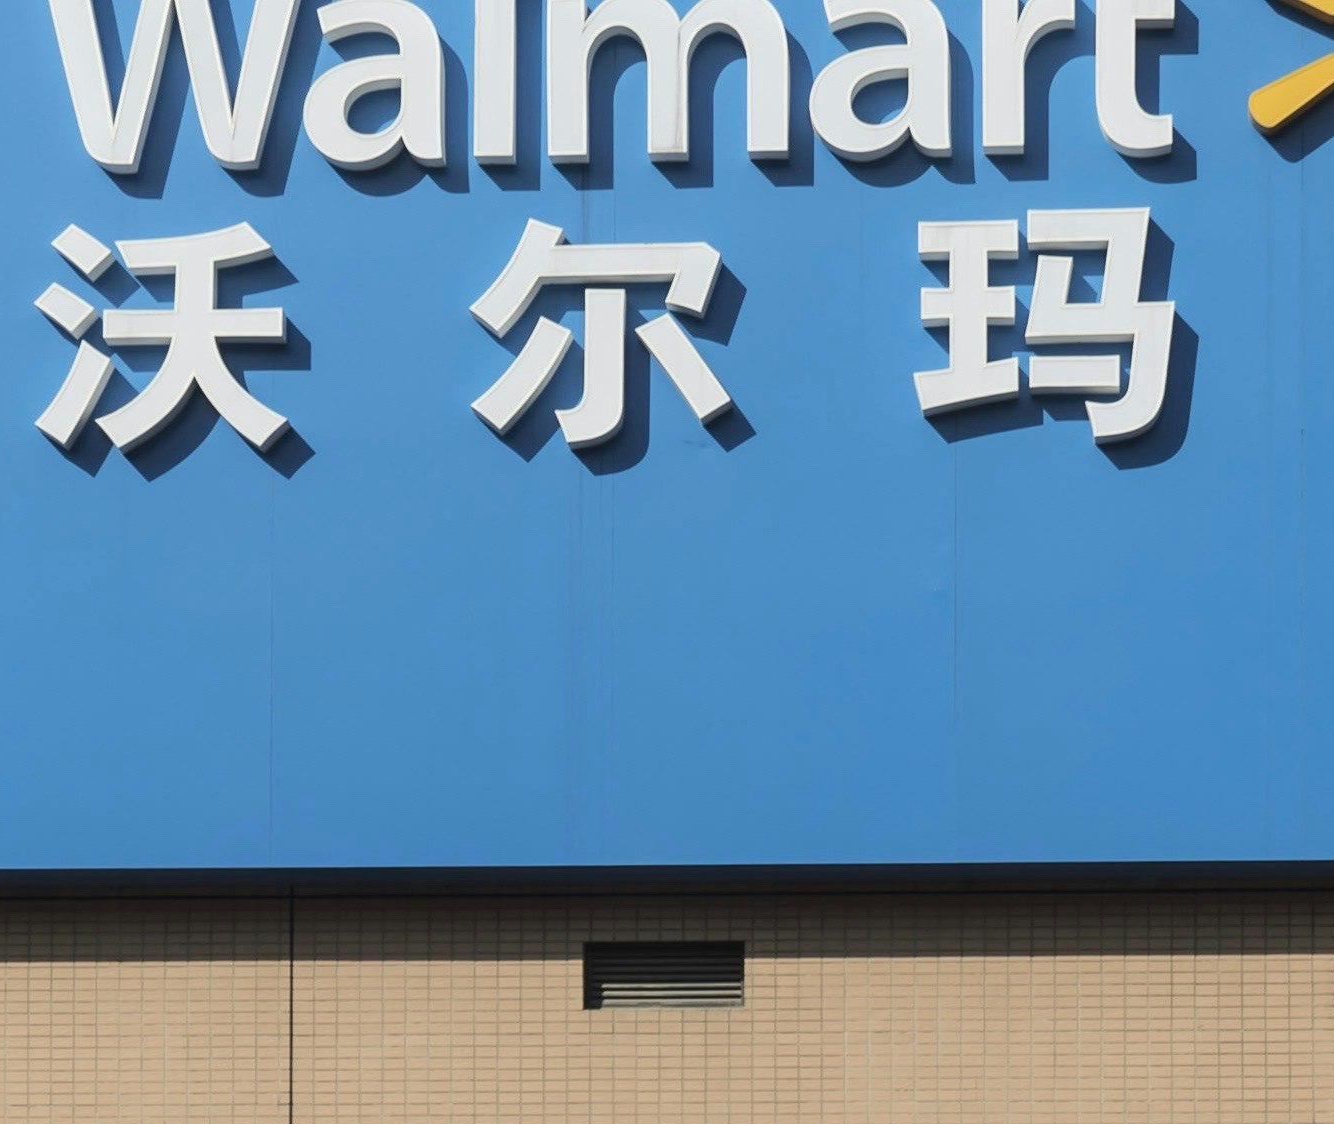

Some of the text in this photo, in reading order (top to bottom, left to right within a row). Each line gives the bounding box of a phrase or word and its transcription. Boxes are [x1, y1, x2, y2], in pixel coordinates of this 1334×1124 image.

[49, 0, 1174, 173] Walmart
[34, 206, 1176, 450] 沃尔玛
